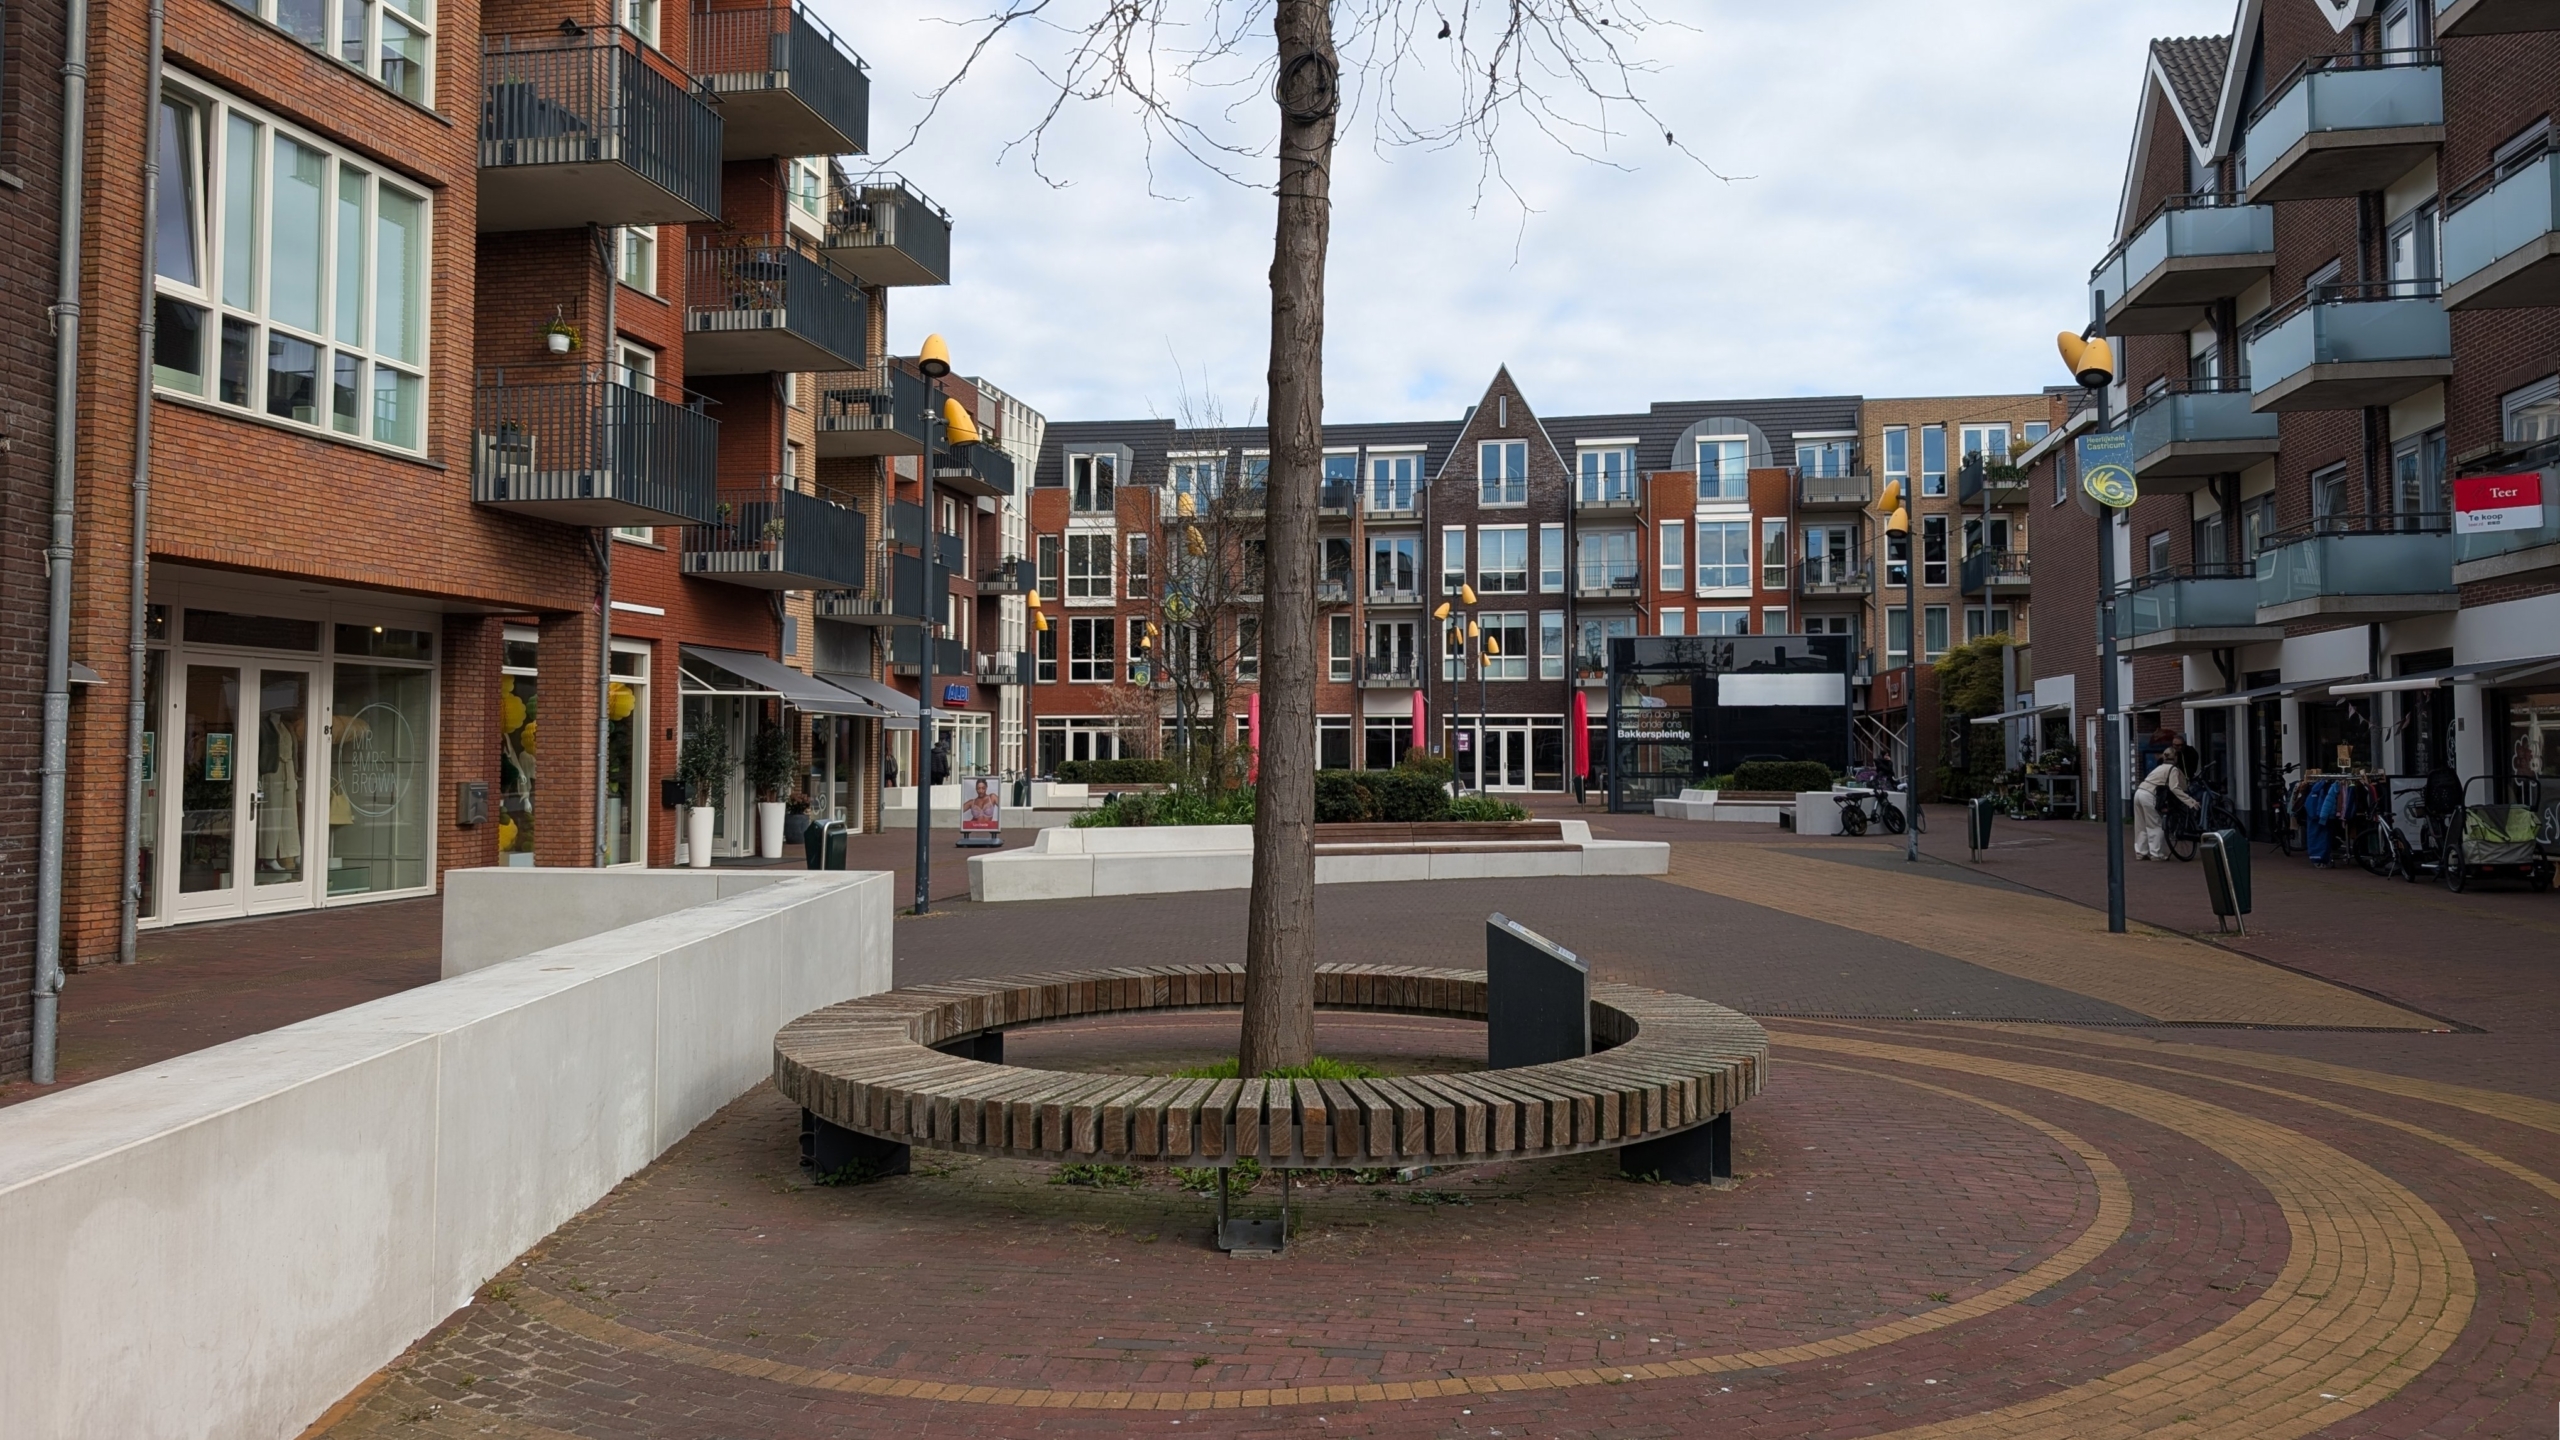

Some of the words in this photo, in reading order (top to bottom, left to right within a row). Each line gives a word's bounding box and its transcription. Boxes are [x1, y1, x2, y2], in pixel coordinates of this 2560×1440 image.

[2086, 434, 2125, 443] Heerlijkheid
[2086, 442, 2126, 451] Castricum
[2489, 487, 2518, 498] Teer
[2481, 513, 2503, 521] koop
[948, 684, 970, 701] ALDI
[1654, 709, 1671, 719] doe
[1672, 709, 1680, 720] je
[324, 725, 333, 735] 81
[1641, 720, 1665, 729] onder
[1666, 721, 1682, 729] ons
[353, 729, 374, 750] MR
[1617, 729, 1691, 740] Bakkerspleintje
[352, 772, 399, 794] BROWN
